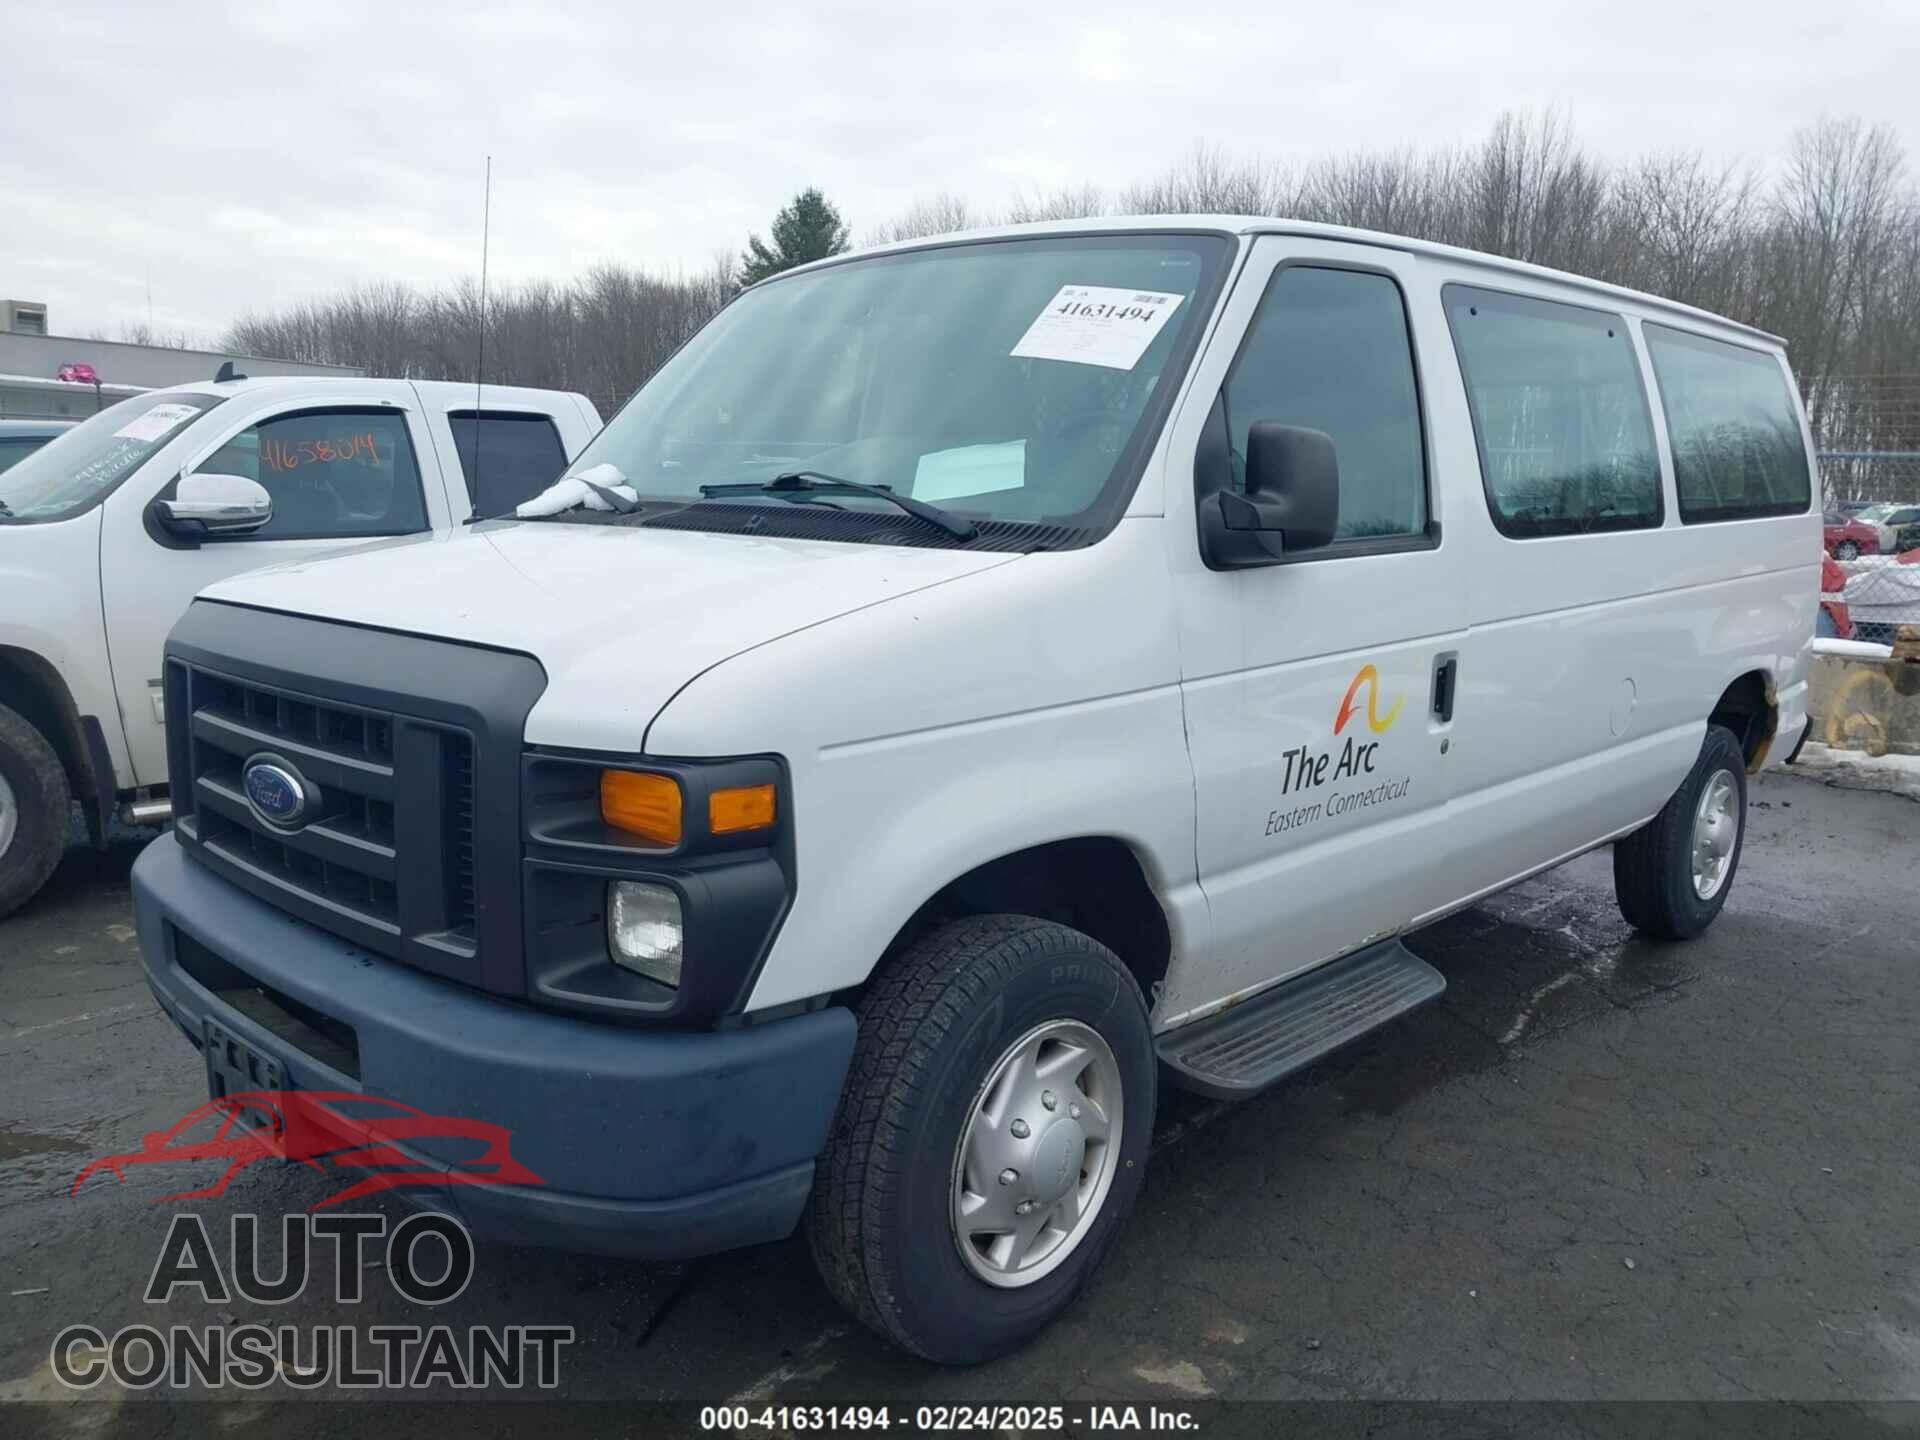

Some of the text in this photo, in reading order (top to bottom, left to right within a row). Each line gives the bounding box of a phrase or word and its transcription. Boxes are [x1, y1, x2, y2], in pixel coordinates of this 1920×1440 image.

[1057, 301, 1156, 322] 41631494
[1281, 737, 1379, 795] The Arc
[1264, 777, 1410, 836] Eastern Connecticut
